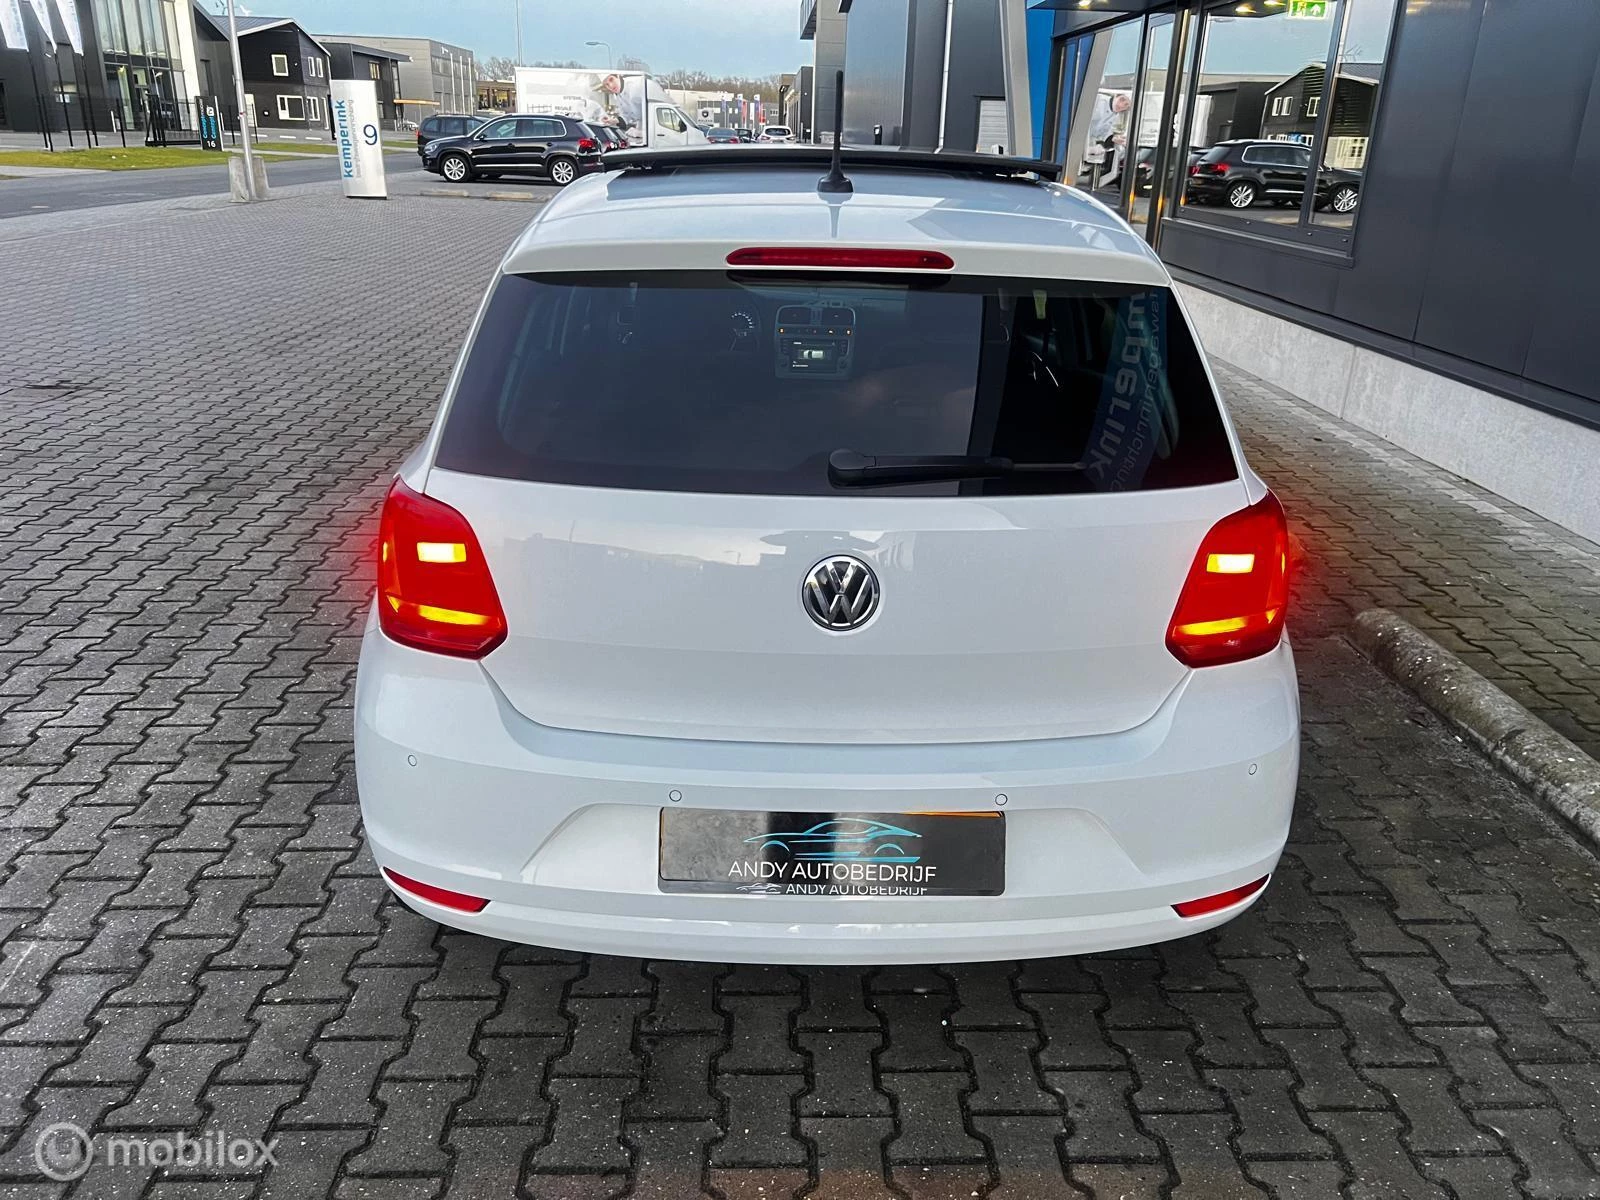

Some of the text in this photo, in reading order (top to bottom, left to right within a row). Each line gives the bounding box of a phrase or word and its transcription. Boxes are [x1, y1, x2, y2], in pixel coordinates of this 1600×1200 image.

[207, 140, 216, 148] 16
[335, 99, 354, 178] kemperink
[363, 124, 378, 146] 9
[727, 860, 937, 883] ANDY AUTOBEDRIJF
[785, 883, 928, 896] ANDY AUTOBEDRIJF
